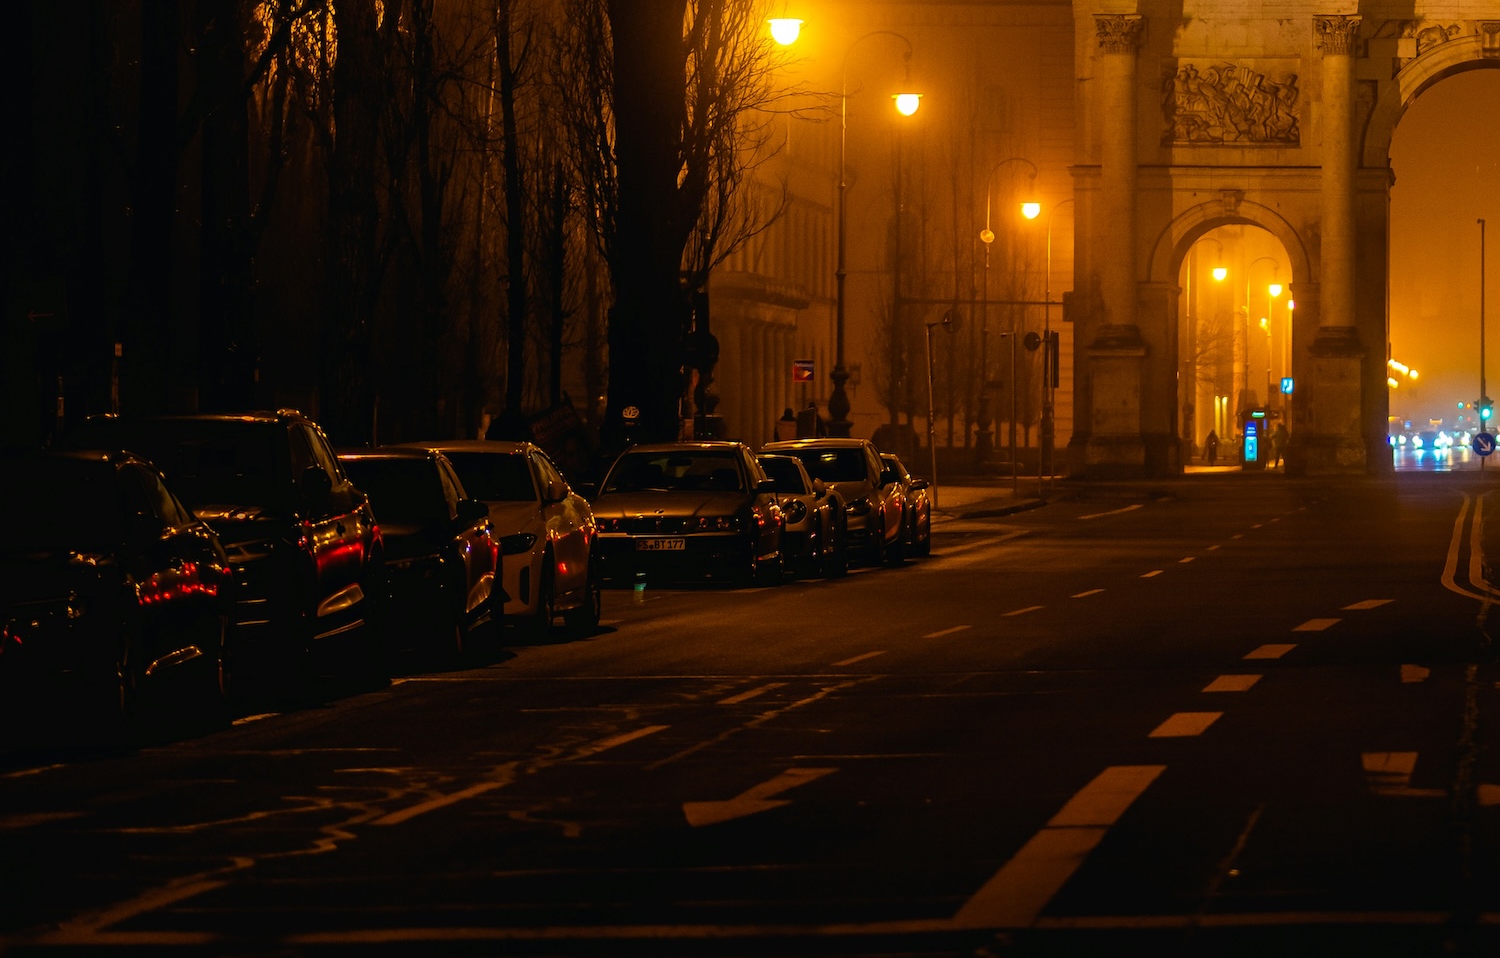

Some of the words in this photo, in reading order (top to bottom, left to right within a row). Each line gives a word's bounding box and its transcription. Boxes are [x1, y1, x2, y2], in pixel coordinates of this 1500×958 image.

[637, 540, 649, 549] FS
[654, 540, 666, 549] BT
[667, 539, 684, 549] 177
